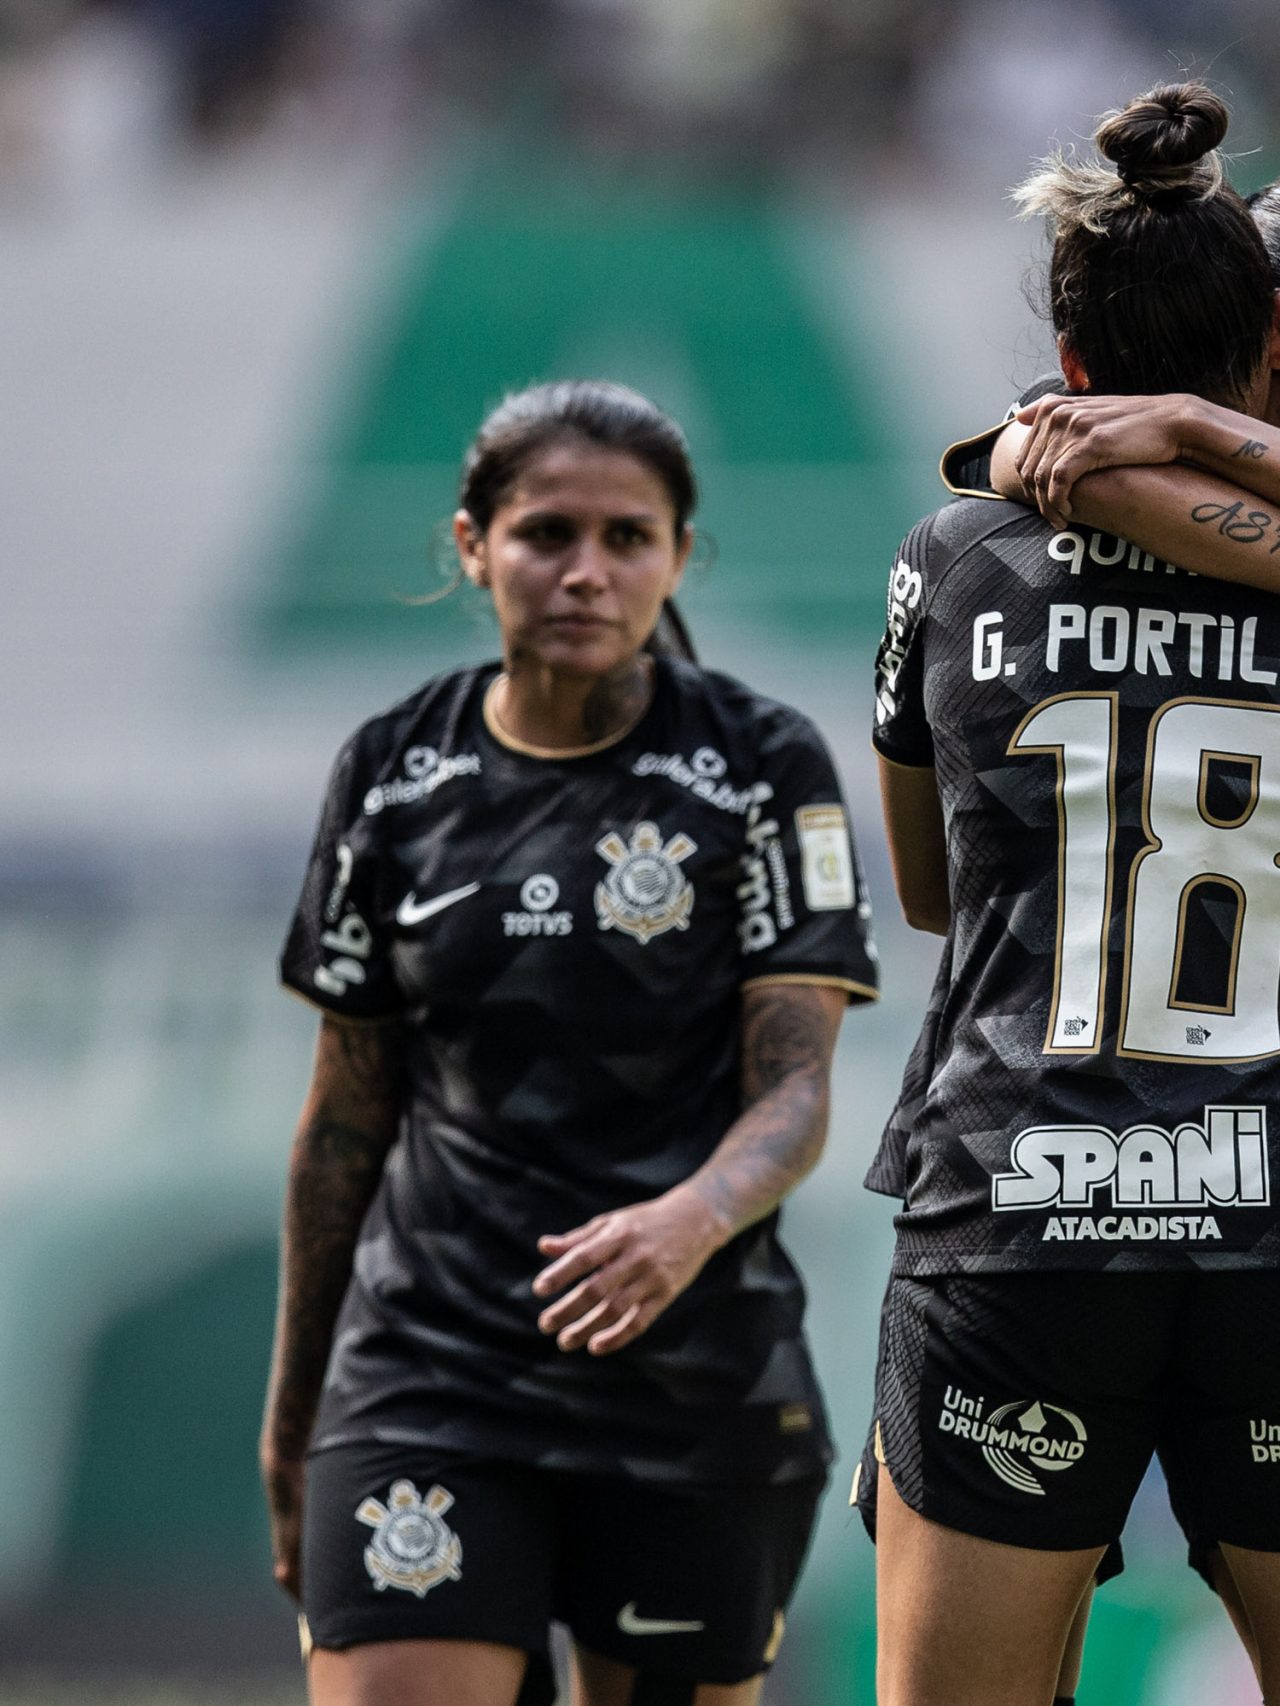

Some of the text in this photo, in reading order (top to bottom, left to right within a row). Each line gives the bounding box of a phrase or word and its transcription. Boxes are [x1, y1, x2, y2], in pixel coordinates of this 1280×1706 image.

[972, 610, 1017, 681] G.
[501, 911, 573, 936] TOTVS
[1042, 1216, 1222, 1241] ATACADISTA
[943, 1385, 984, 1419] Uni
[939, 1408, 1086, 1461] DRUMMOND
